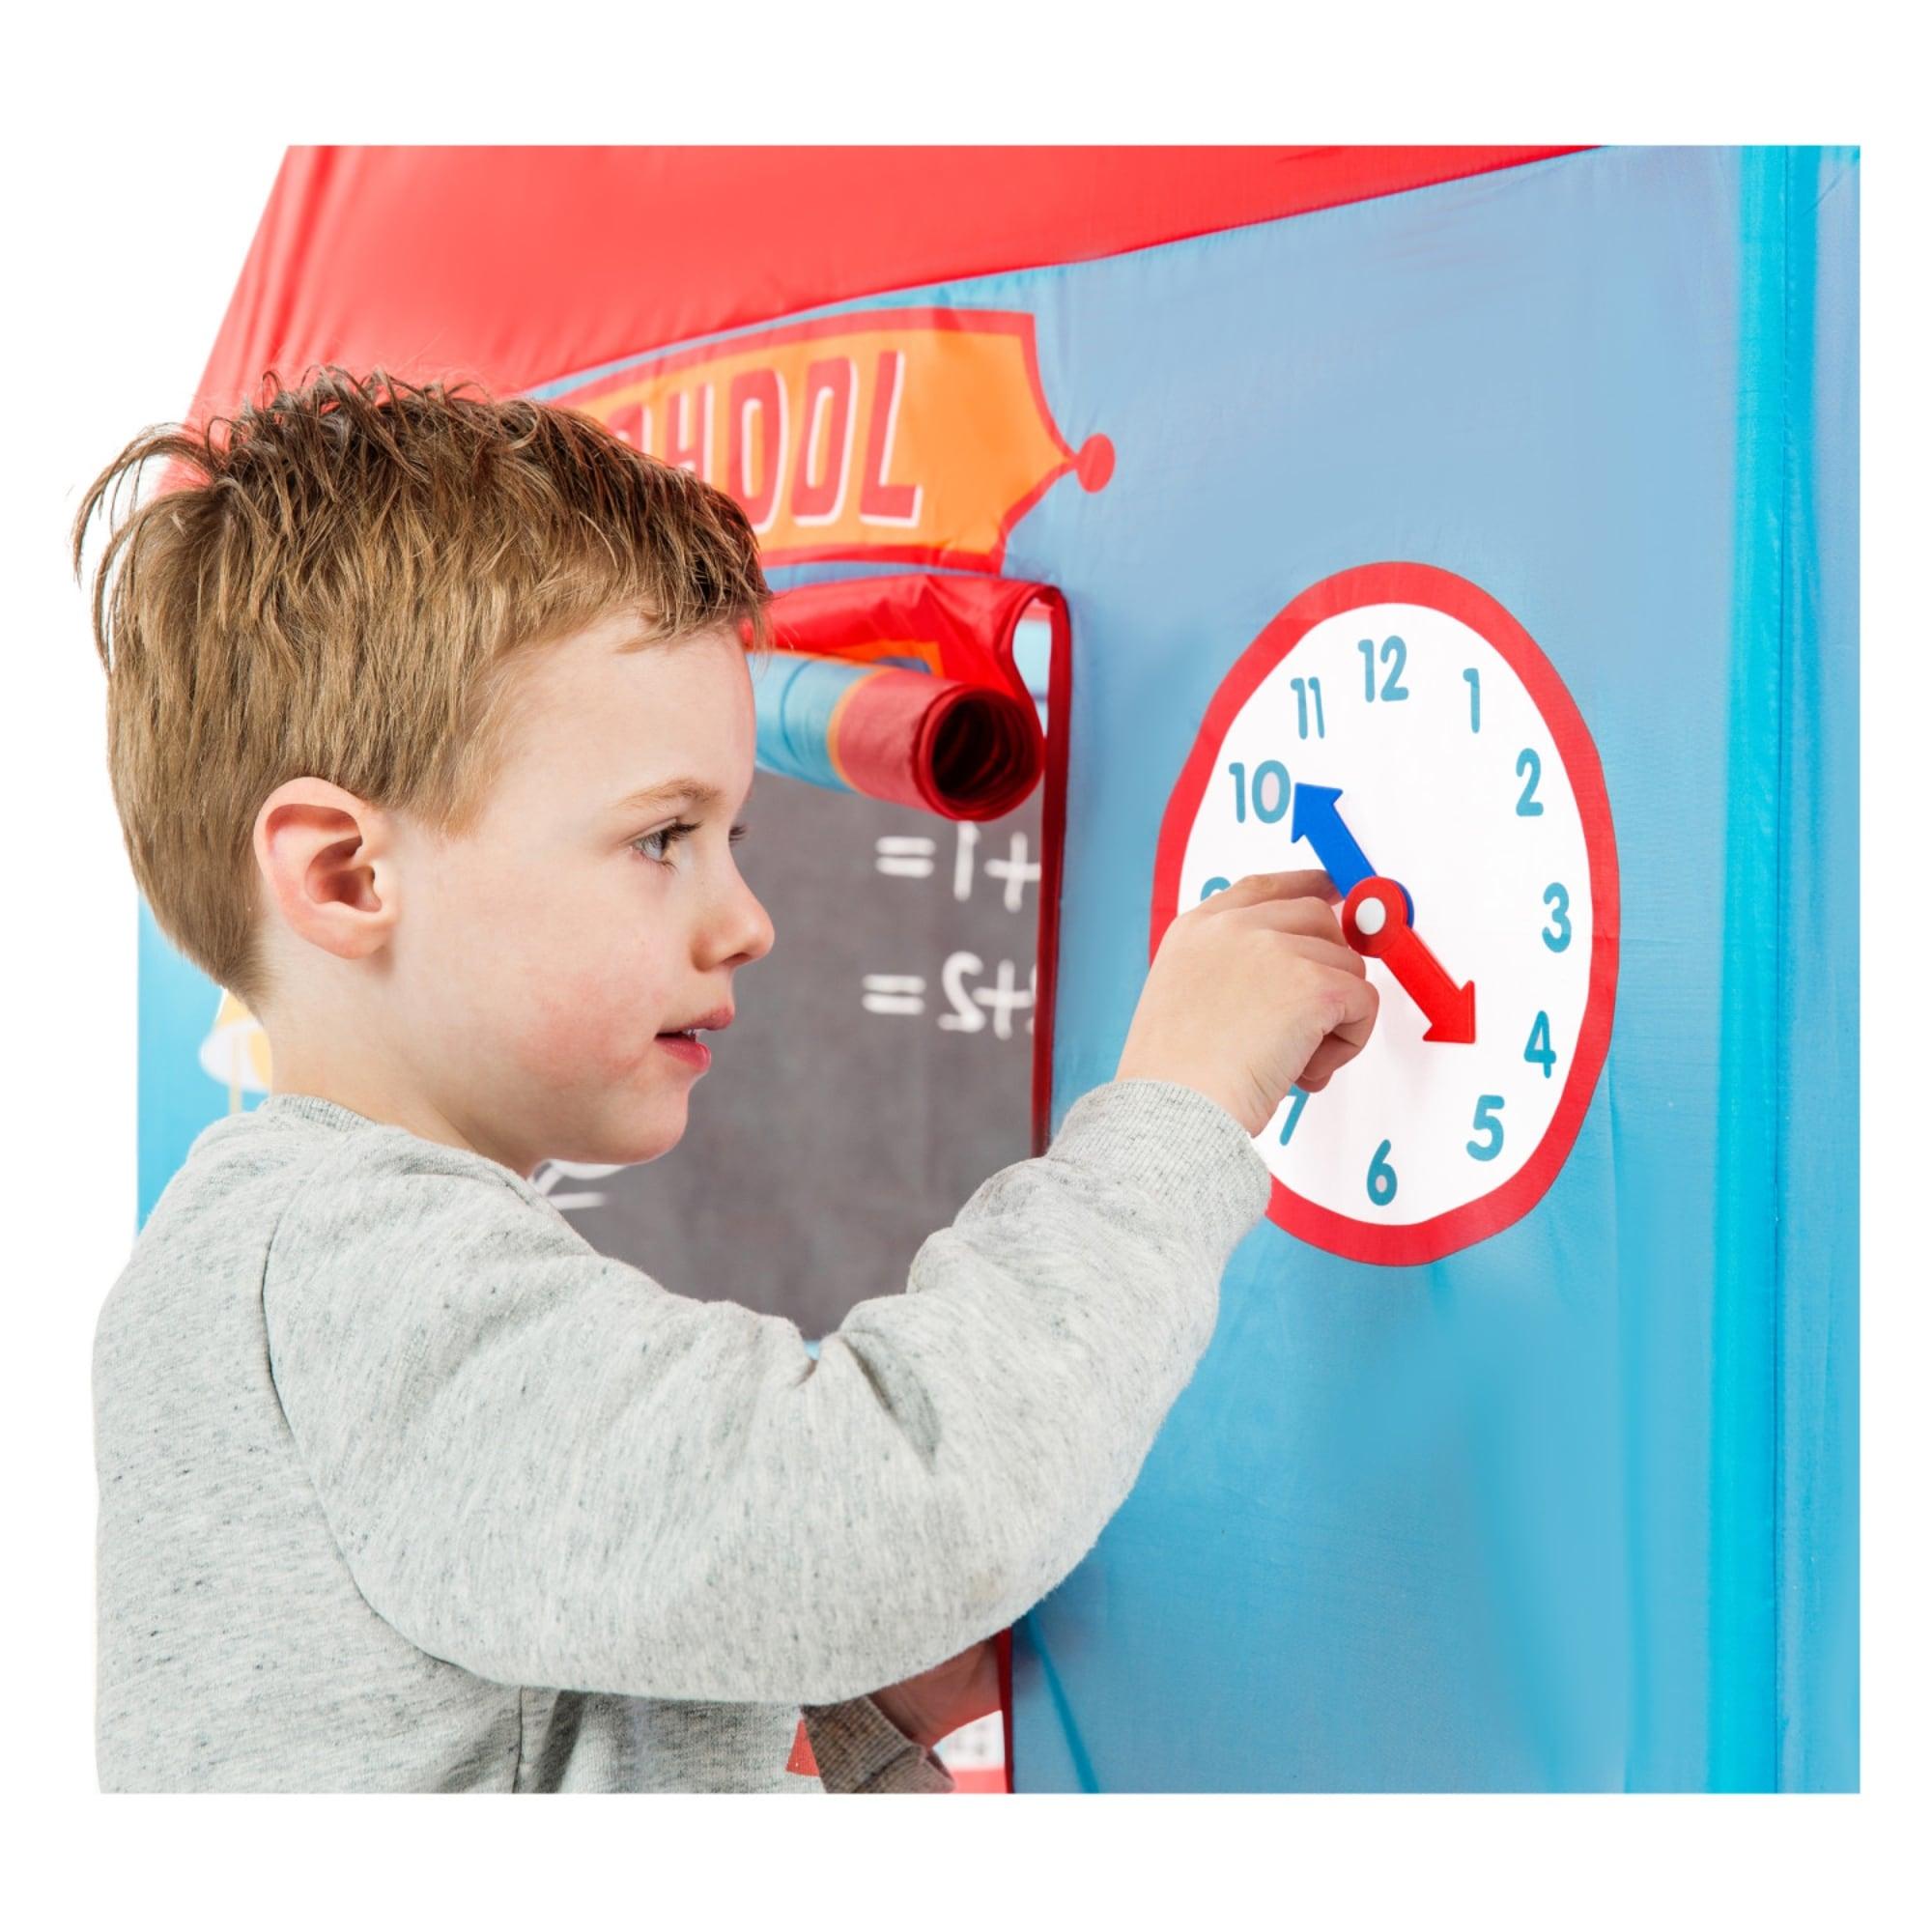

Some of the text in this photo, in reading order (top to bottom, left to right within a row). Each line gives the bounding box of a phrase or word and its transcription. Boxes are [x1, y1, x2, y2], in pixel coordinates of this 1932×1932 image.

[1358, 636, 1409, 702] 12
[1462, 668, 1481, 733] 1
[1291, 675, 1326, 739] 11
[1228, 758, 1292, 824] 10
[1515, 747, 1545, 817] 2
[1540, 881, 1573, 954] 3
[1522, 1009, 1558, 1080] 4
[1279, 1083, 1310, 1147] 7
[1465, 1094, 1506, 1162] 5
[1365, 1138, 1399, 1208] 6
